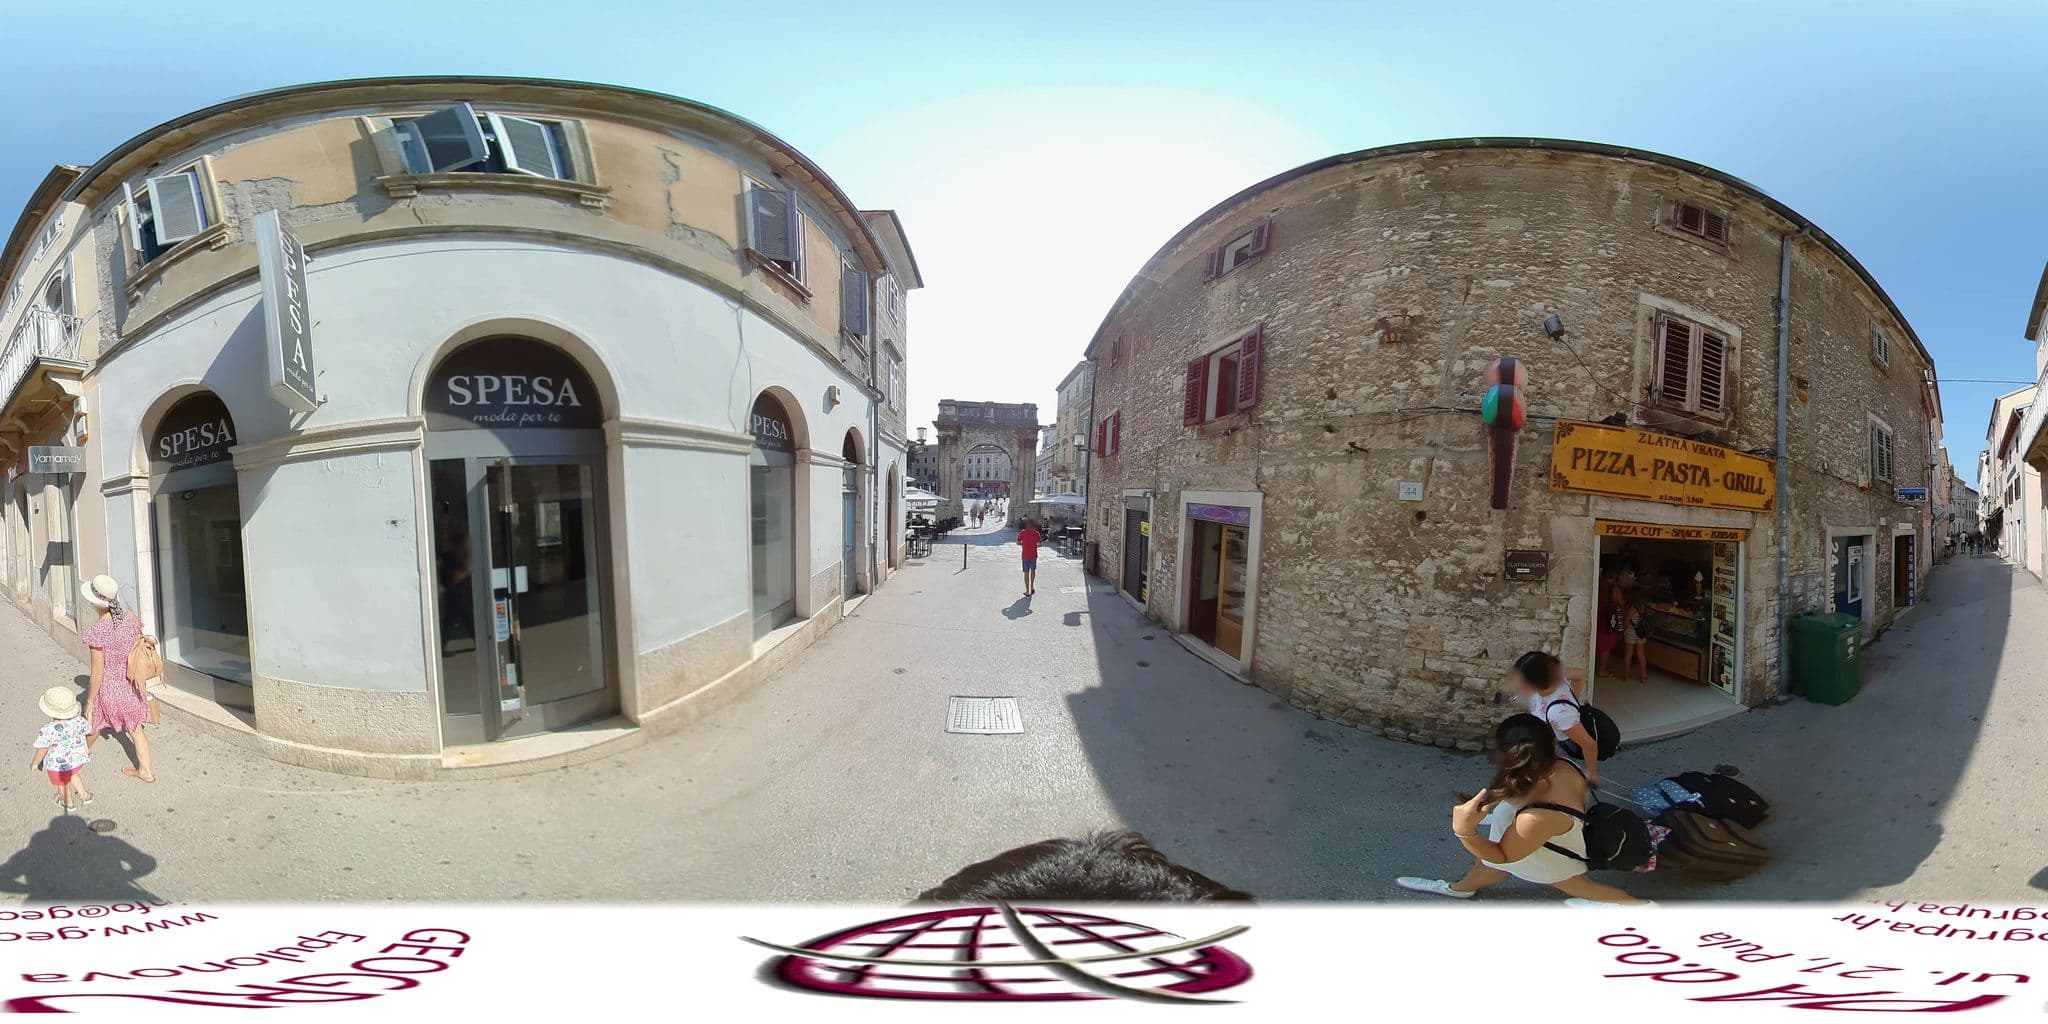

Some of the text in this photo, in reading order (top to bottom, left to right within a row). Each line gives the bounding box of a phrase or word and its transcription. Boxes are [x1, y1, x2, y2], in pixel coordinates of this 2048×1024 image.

[279, 231, 308, 374] SPESA
[447, 375, 582, 407] SPESA
[473, 406, 563, 428] moda per te
[751, 414, 788, 440] PESA
[160, 418, 233, 458] SPESA
[1638, 433, 1725, 459] ZLATNA VRATA
[33, 454, 82, 465] yamamay
[1571, 447, 1636, 477] PIZZA
[1652, 458, 1710, 487] PASTA
[1723, 471, 1766, 496] GRILL
[1404, 487, 1417, 496] 44
[1659, 494, 1684, 502] since
[1606, 524, 1638, 536] PIZZA
[1641, 526, 1663, 537] CUT
[1671, 529, 1703, 539] SNACK
[1711, 530, 1739, 540] KEBAB
